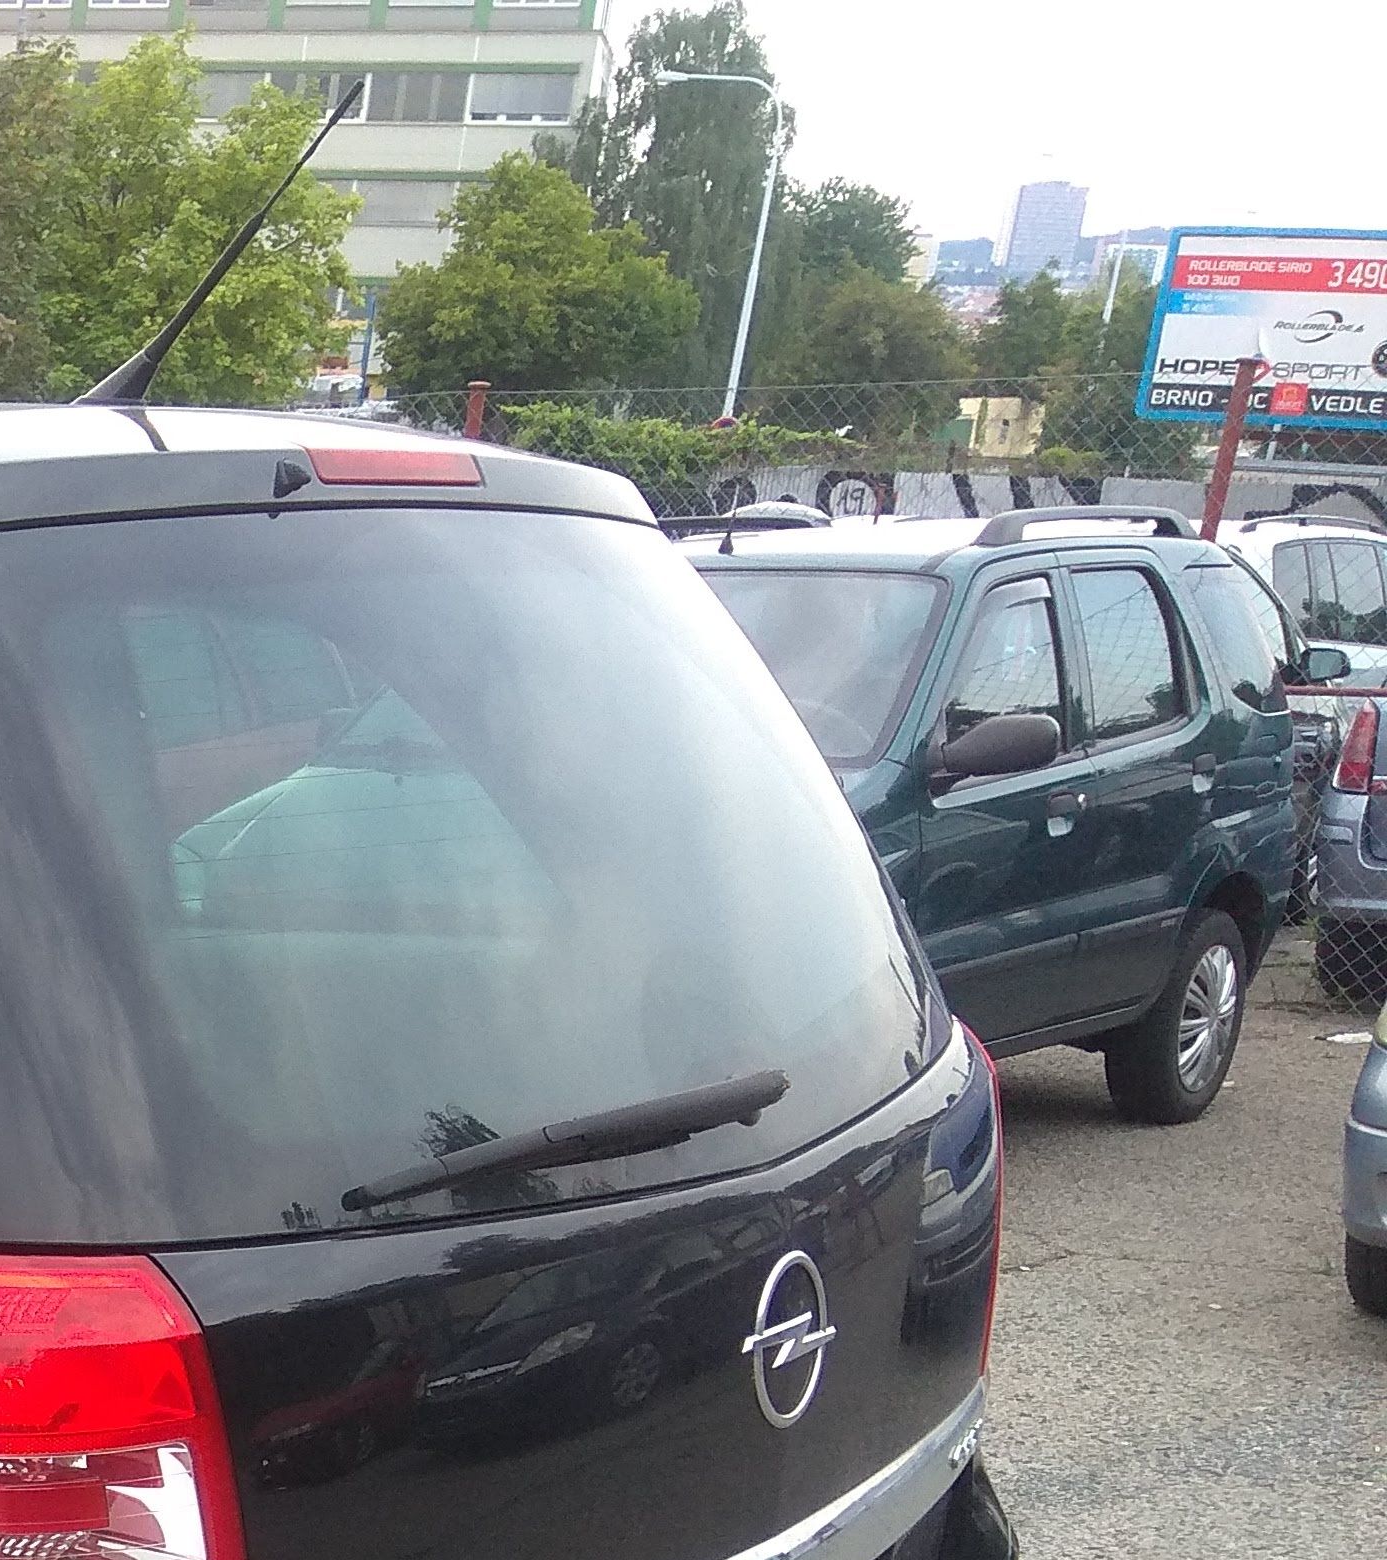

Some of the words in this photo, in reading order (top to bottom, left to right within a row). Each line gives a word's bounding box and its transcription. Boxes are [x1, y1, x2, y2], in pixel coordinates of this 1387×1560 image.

[1272, 362, 1368, 380] SPORT
[1150, 389, 1214, 407] BRNO
[1310, 394, 1384, 414] VEDLE
